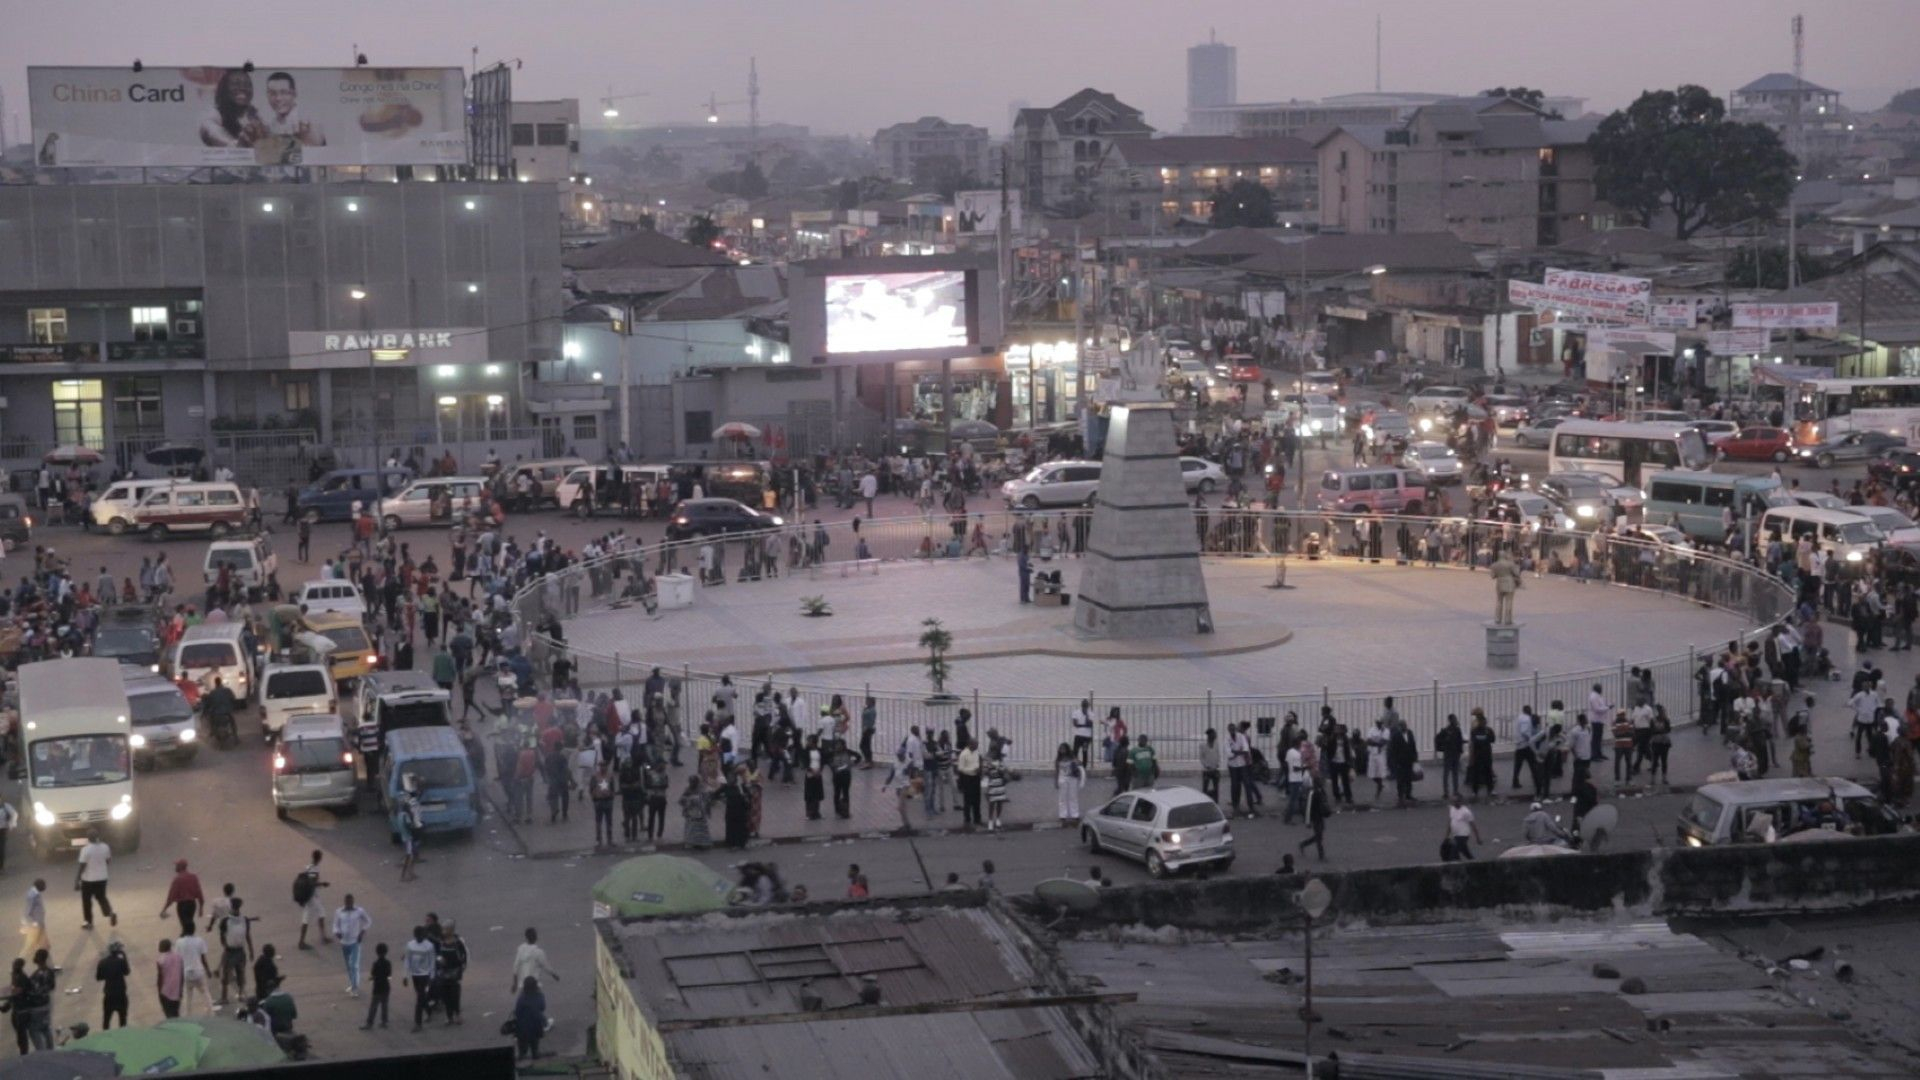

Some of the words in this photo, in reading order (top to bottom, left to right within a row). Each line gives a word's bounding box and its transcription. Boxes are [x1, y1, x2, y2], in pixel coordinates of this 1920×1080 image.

[53, 83, 122, 102] China
[128, 83, 185, 103] Card
[1549, 275, 1641, 295] FABREGAS
[325, 332, 452, 350] RAWBANK
